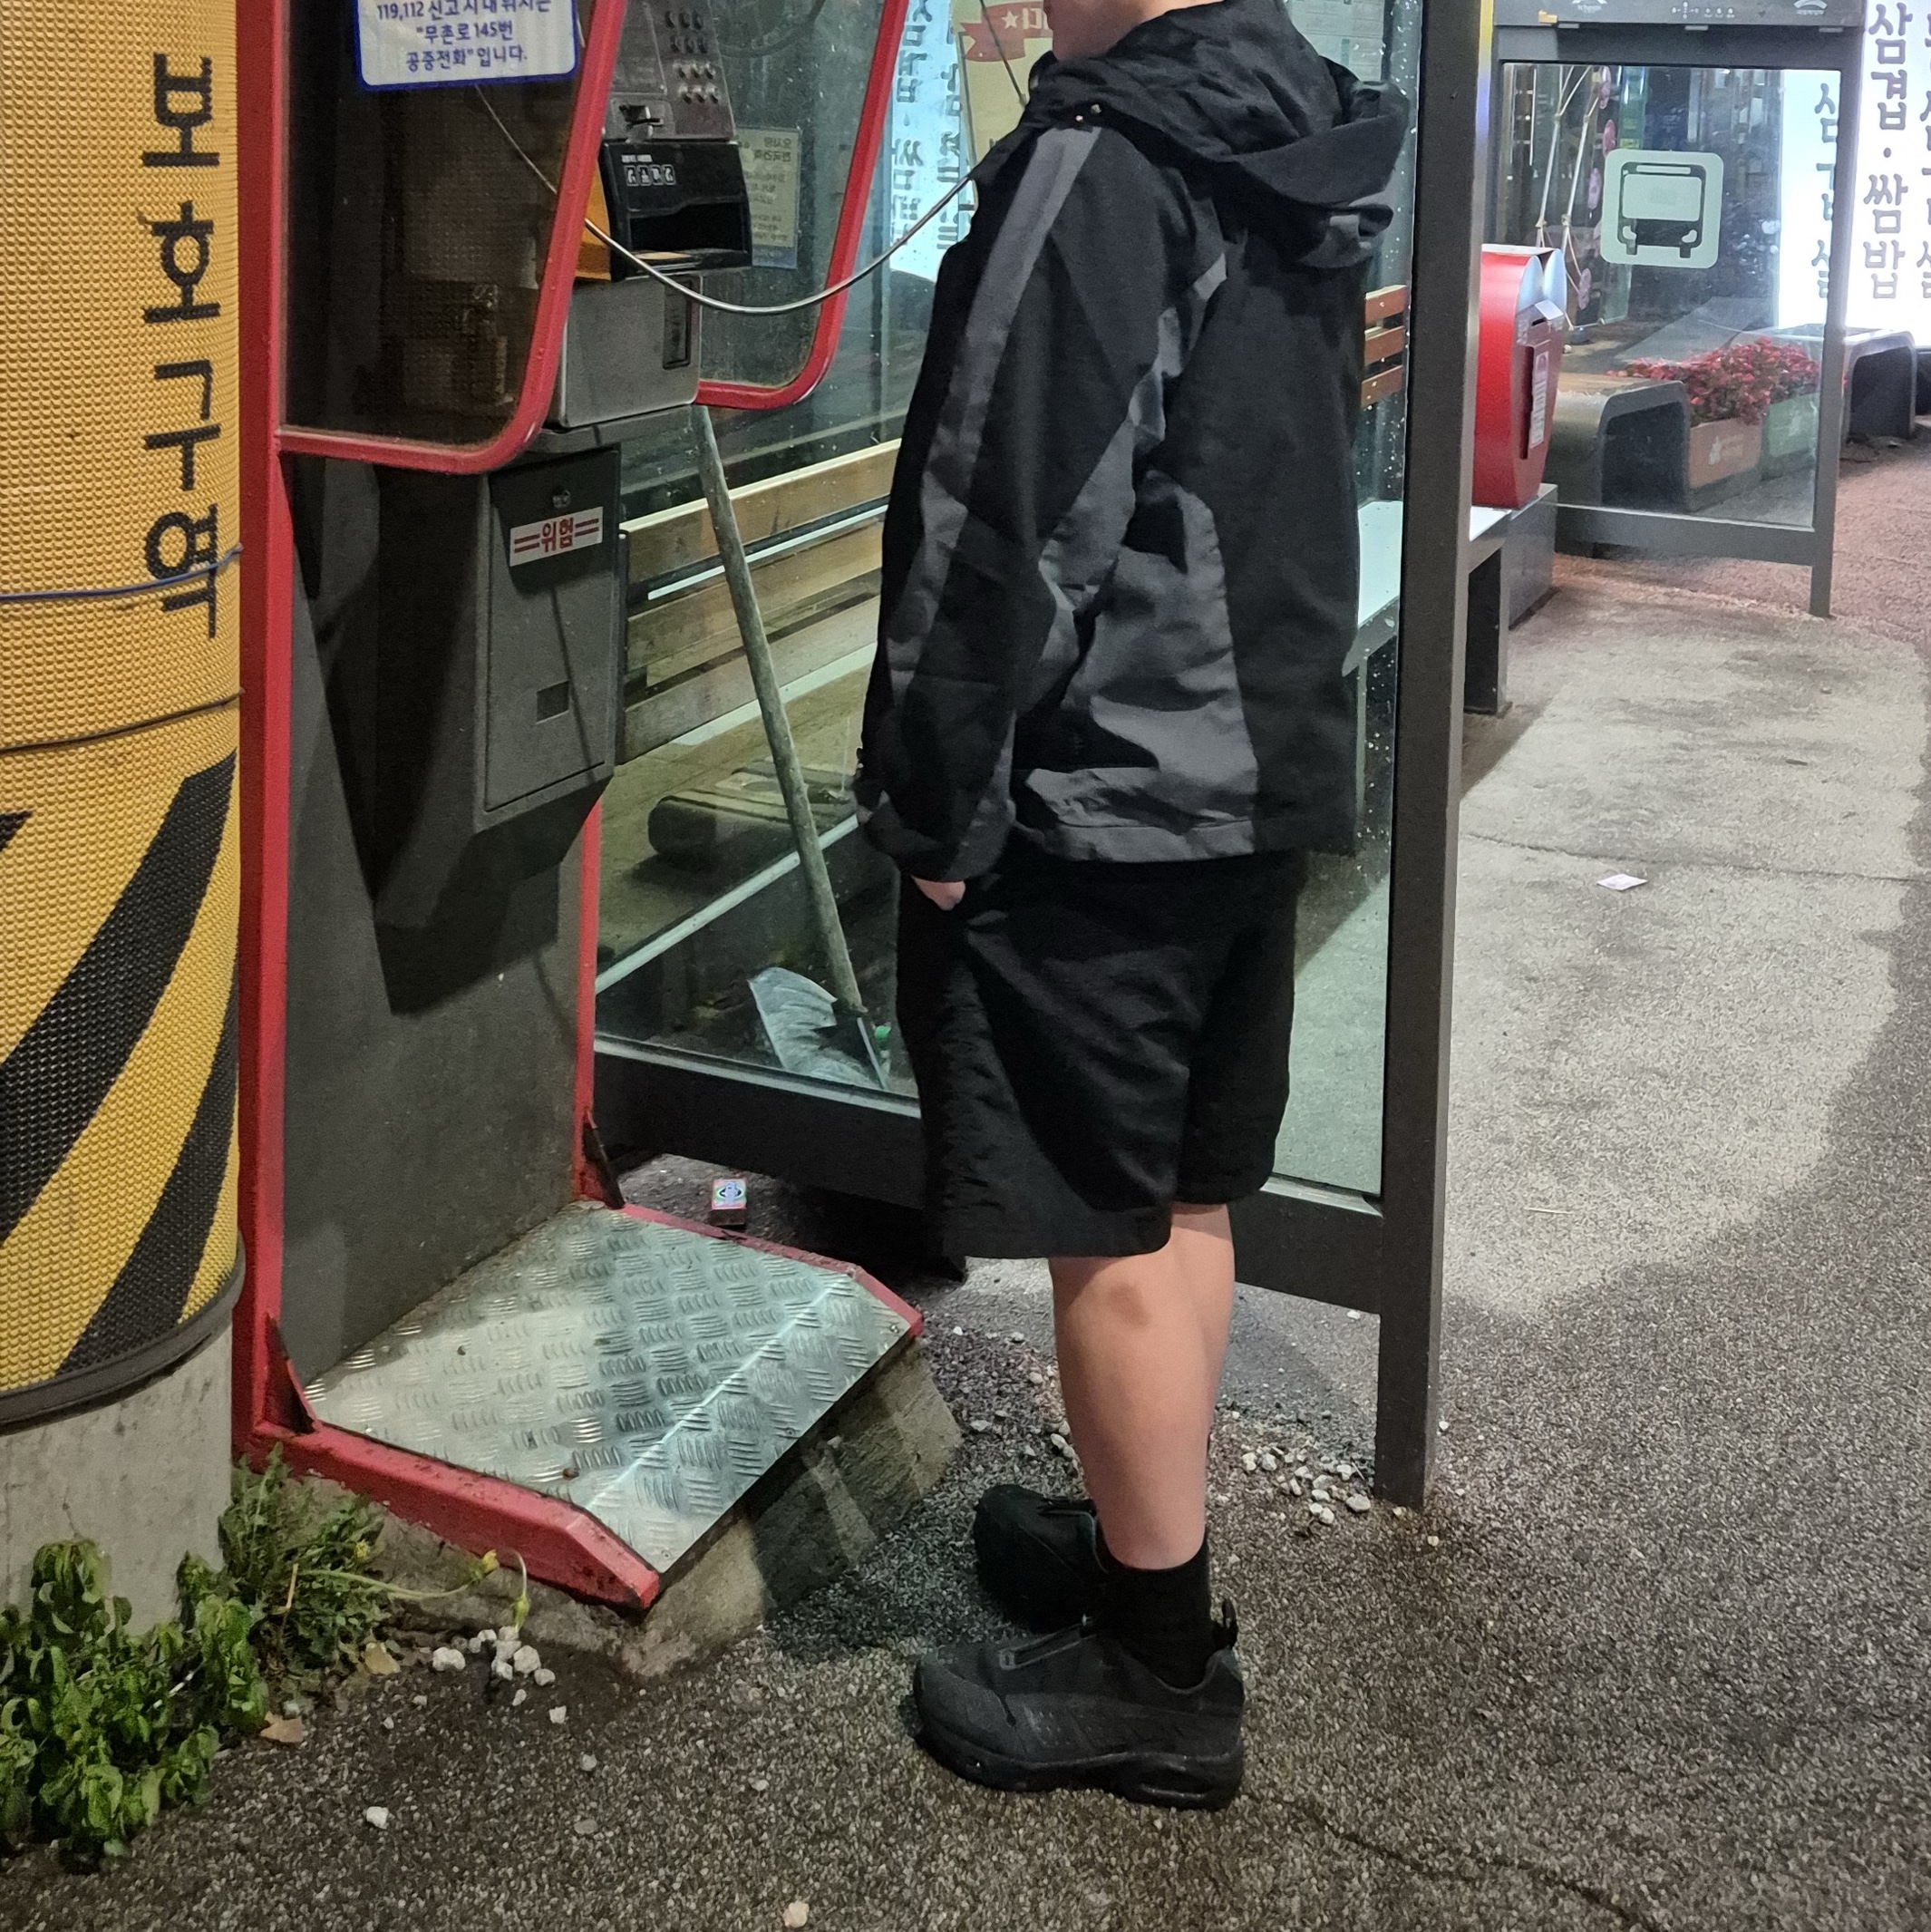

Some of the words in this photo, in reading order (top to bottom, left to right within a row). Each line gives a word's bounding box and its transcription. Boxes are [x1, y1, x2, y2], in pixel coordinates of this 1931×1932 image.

[377, 2, 424, 21] 119,112
[141, 52, 221, 639] 보호구역
[541, 517, 574, 553] 위험
